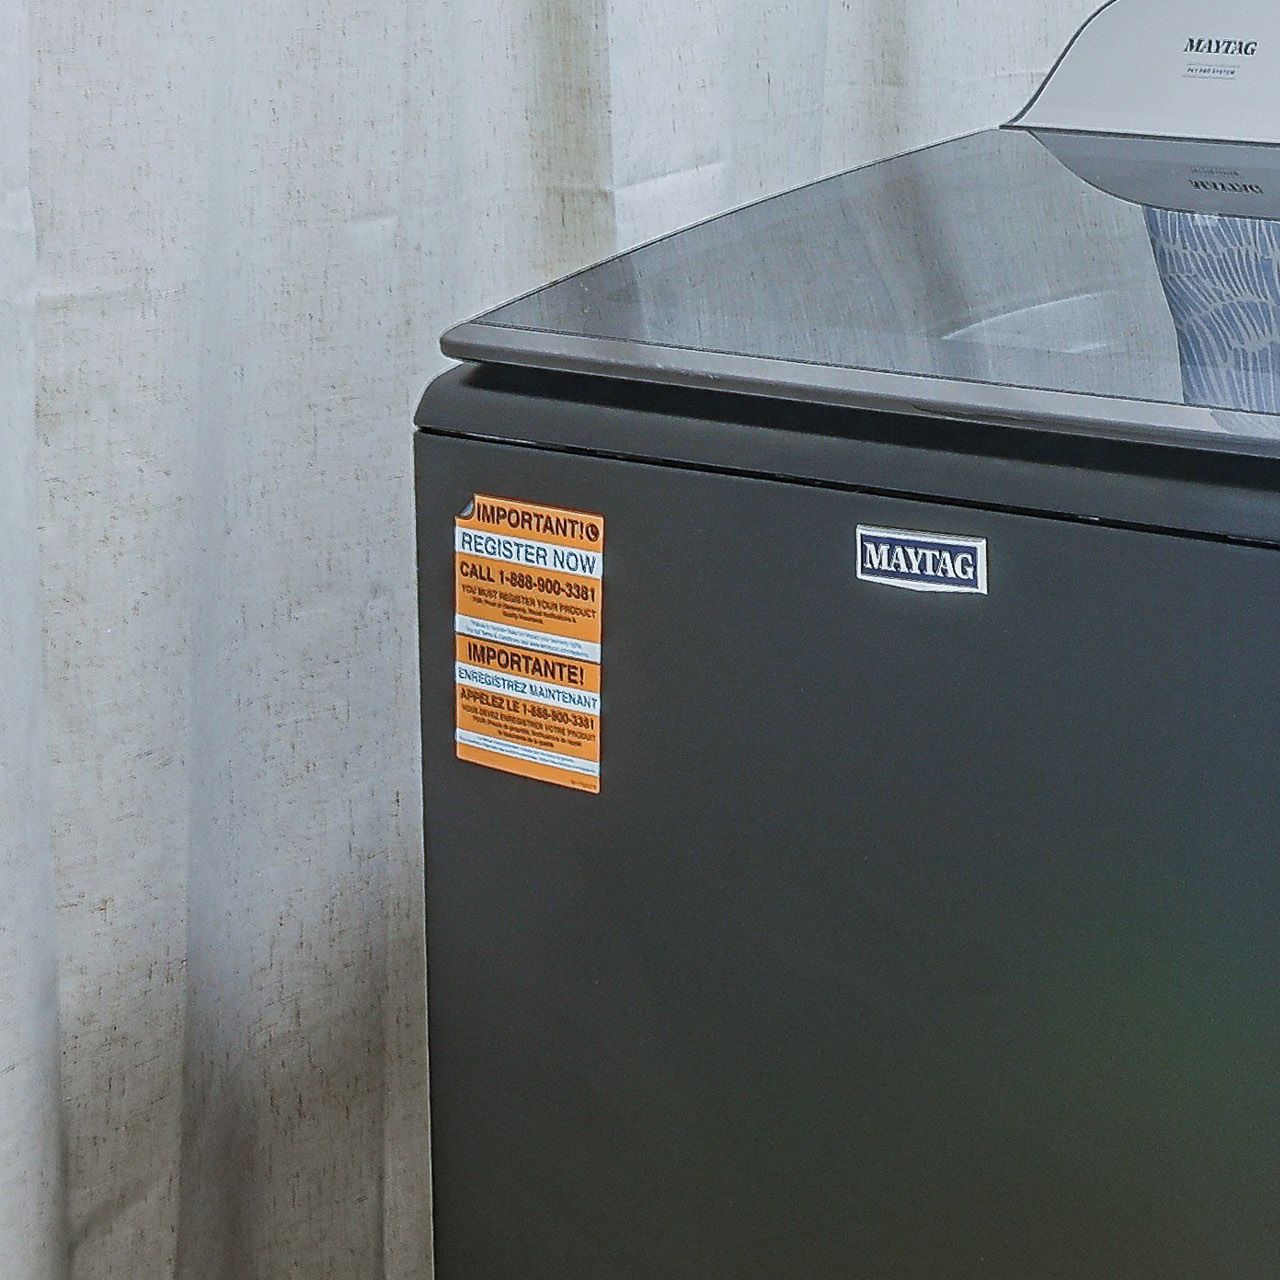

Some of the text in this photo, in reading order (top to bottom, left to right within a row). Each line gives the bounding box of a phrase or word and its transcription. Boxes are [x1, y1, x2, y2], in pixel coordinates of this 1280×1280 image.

[1183, 38, 1258, 55] MAYTAG
[476, 502, 584, 540] IMPORTANT!
[461, 531, 597, 575] REGISTER NOW
[863, 541, 974, 581] MAYTAG
[460, 560, 597, 603] CALL 1-888-900-3381
[467, 641, 585, 686] IMPORTANTE!
[458, 666, 598, 709] ENREGISTREZ MAINTENANT
[460, 687, 506, 710] APPELEZ
[506, 699, 520, 712] LE
